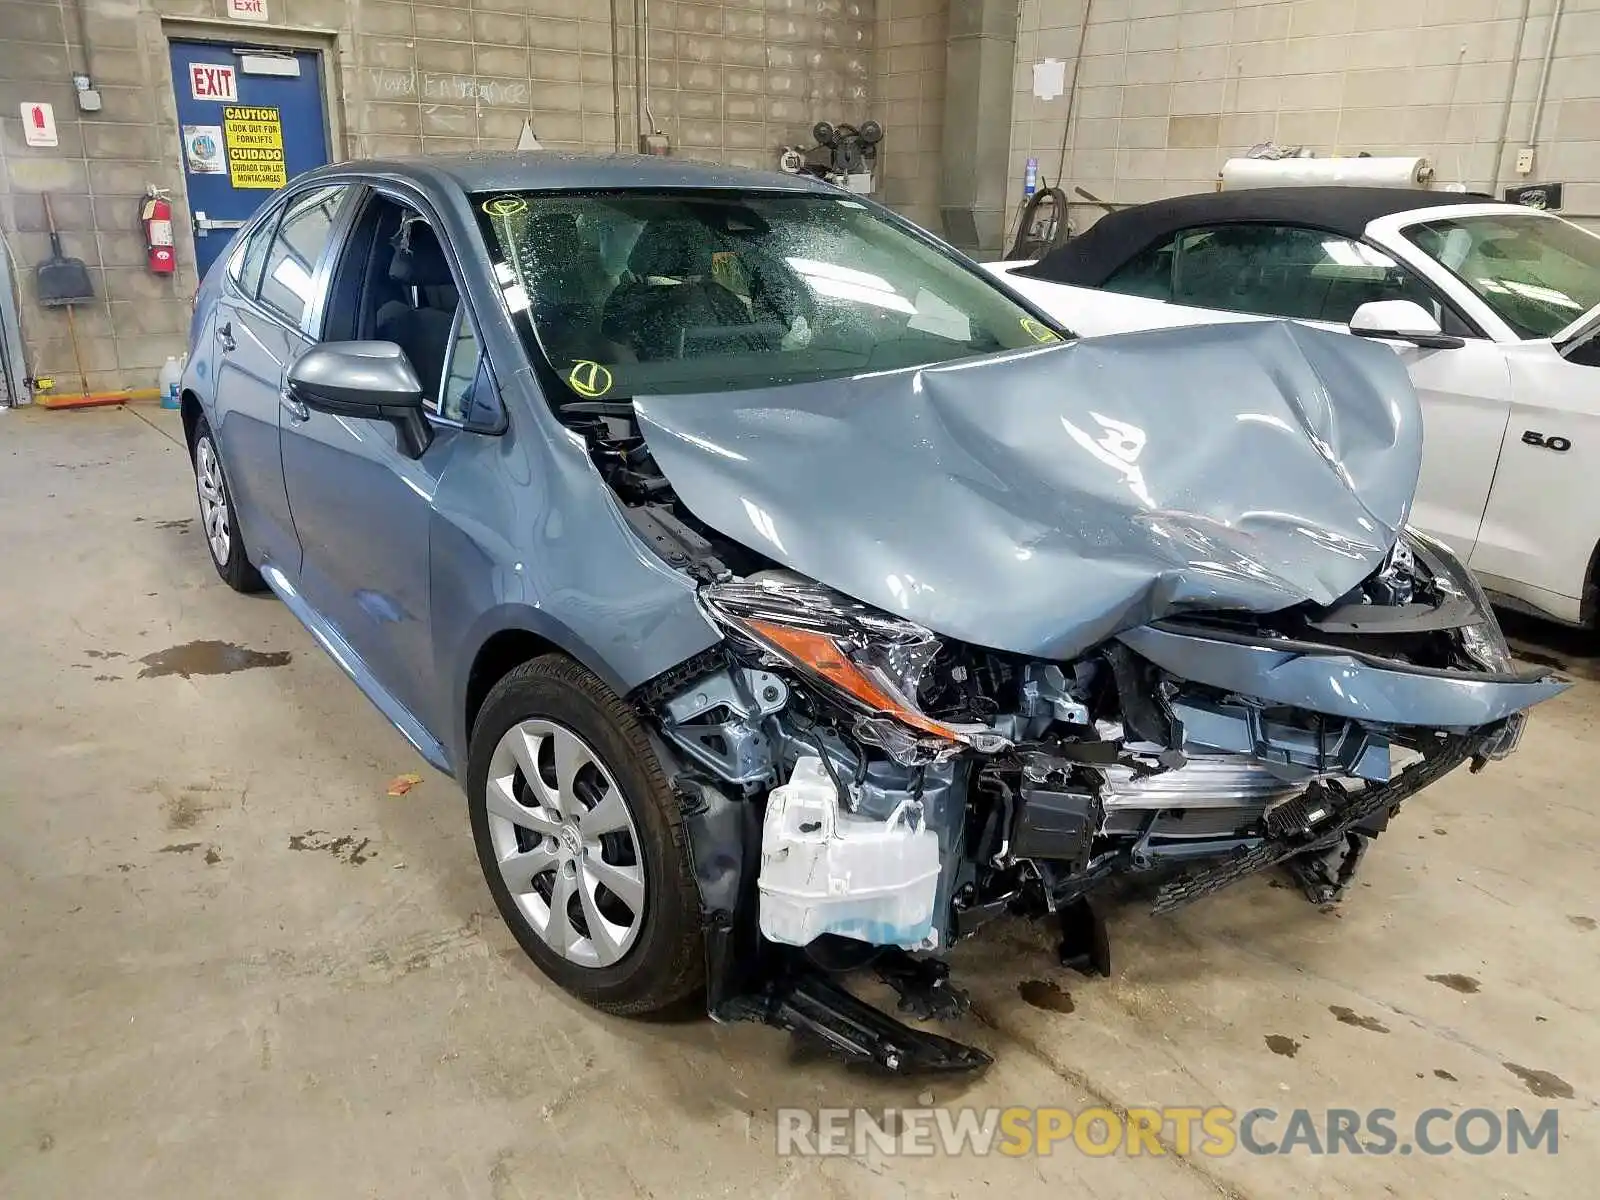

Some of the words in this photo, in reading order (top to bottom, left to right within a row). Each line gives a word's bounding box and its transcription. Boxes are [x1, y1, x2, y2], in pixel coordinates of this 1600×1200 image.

[234, 0, 262, 12] Exit
[193, 68, 231, 96] EXIT
[225, 108, 277, 121] CAUTION
[229, 124, 247, 132] LOOK
[249, 125, 261, 133] OUT
[264, 125, 277, 134] FOR
[236, 135, 272, 144] FORKLIFTS
[230, 149, 281, 160] CUIDADO
[259, 164, 271, 172] CON
[272, 164, 283, 173] LOS
[237, 174, 281, 182] MONTACARGAS
